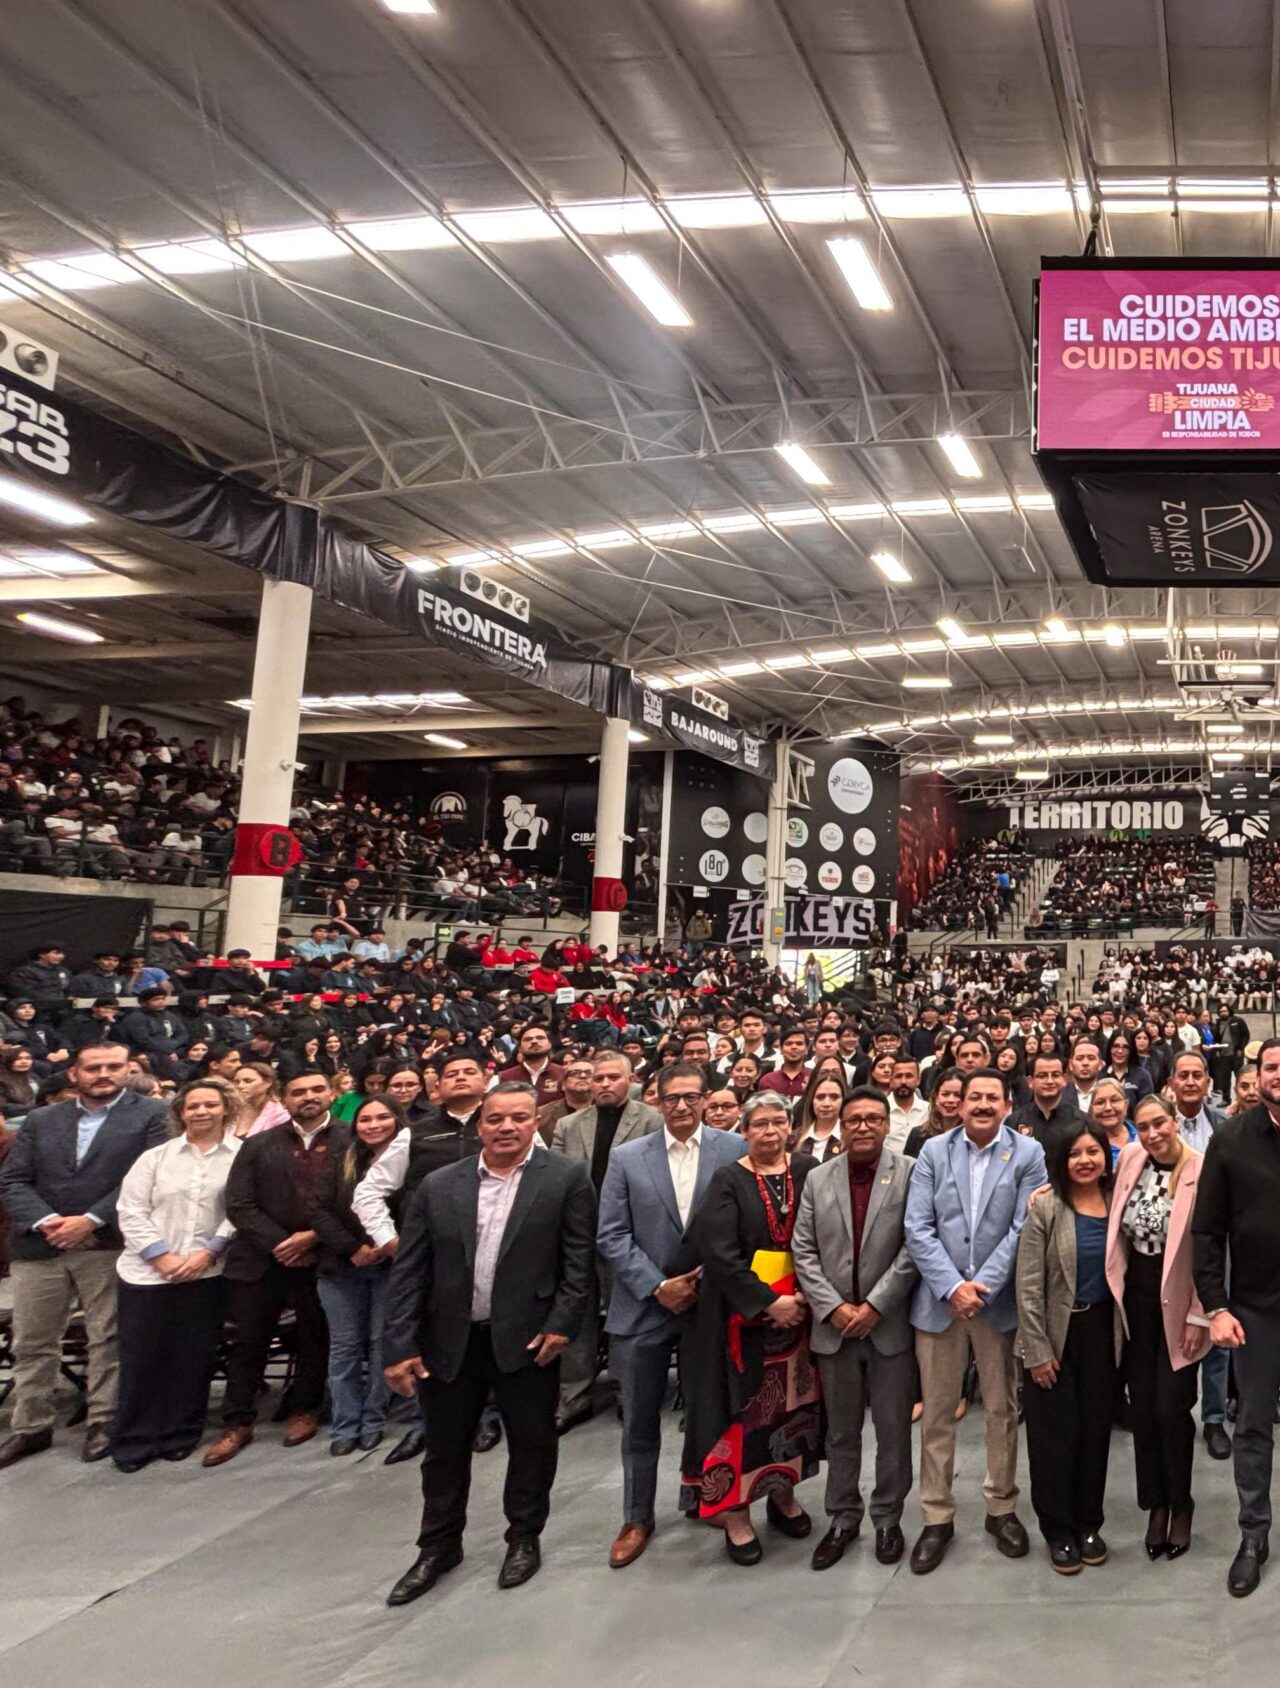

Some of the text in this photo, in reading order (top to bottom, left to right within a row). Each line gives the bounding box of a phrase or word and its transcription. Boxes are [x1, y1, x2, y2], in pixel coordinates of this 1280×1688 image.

[1120, 294, 1280, 318] CUIDEMOS
[1063, 318, 1093, 342] EL
[1103, 318, 1201, 342] MEDIO
[1062, 347, 1223, 370] CUIDEMOS
[1176, 383, 1239, 395] TIJUANA
[1190, 398, 1236, 408] CIUDAD
[1174, 410, 1251, 430] LIMPIA
[1147, 525, 1165, 553] ARENA
[1161, 500, 1196, 572] ZONKEYS
[417, 588, 547, 668] FRONTERA
[671, 711, 738, 752] BAJAROUND
[1005, 800, 1184, 829] TERRITORIO
